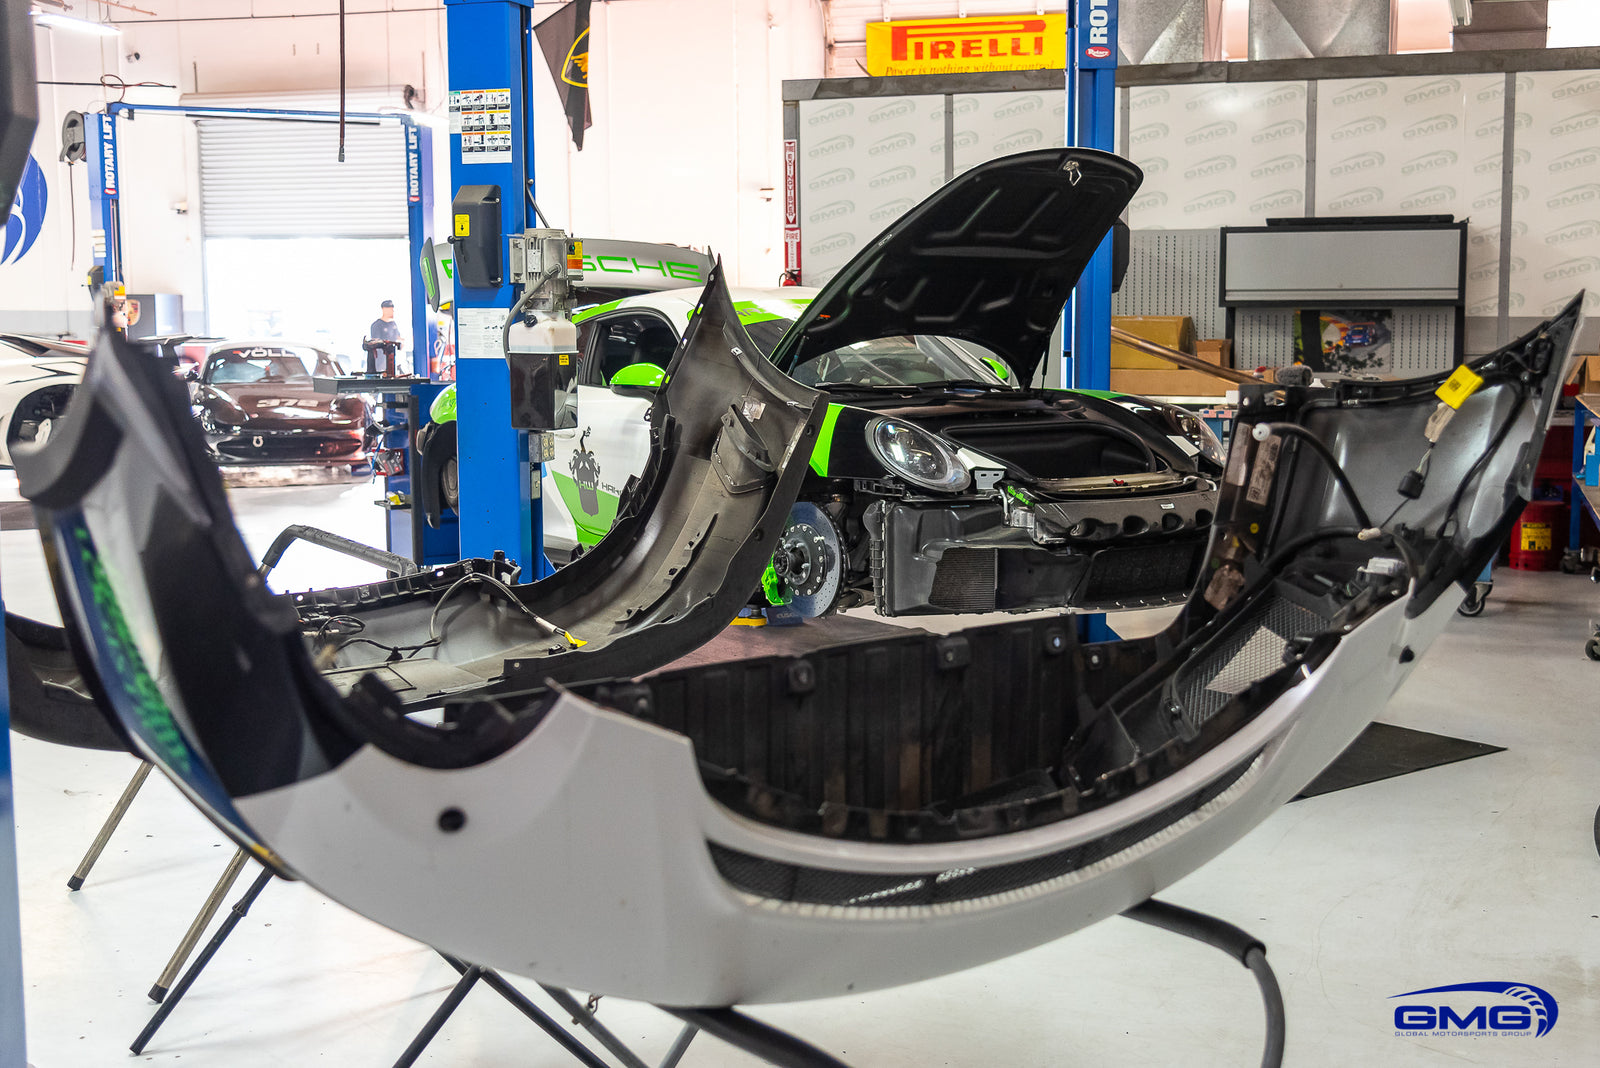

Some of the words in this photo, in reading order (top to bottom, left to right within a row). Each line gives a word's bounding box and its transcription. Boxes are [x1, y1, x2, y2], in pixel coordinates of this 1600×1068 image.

[891, 19, 1046, 61] PIRELLI
[102, 115, 114, 140] LIFT
[408, 126, 418, 150] LIFT
[103, 142, 116, 189] ROTARY
[409, 152, 420, 197] ROTARY
